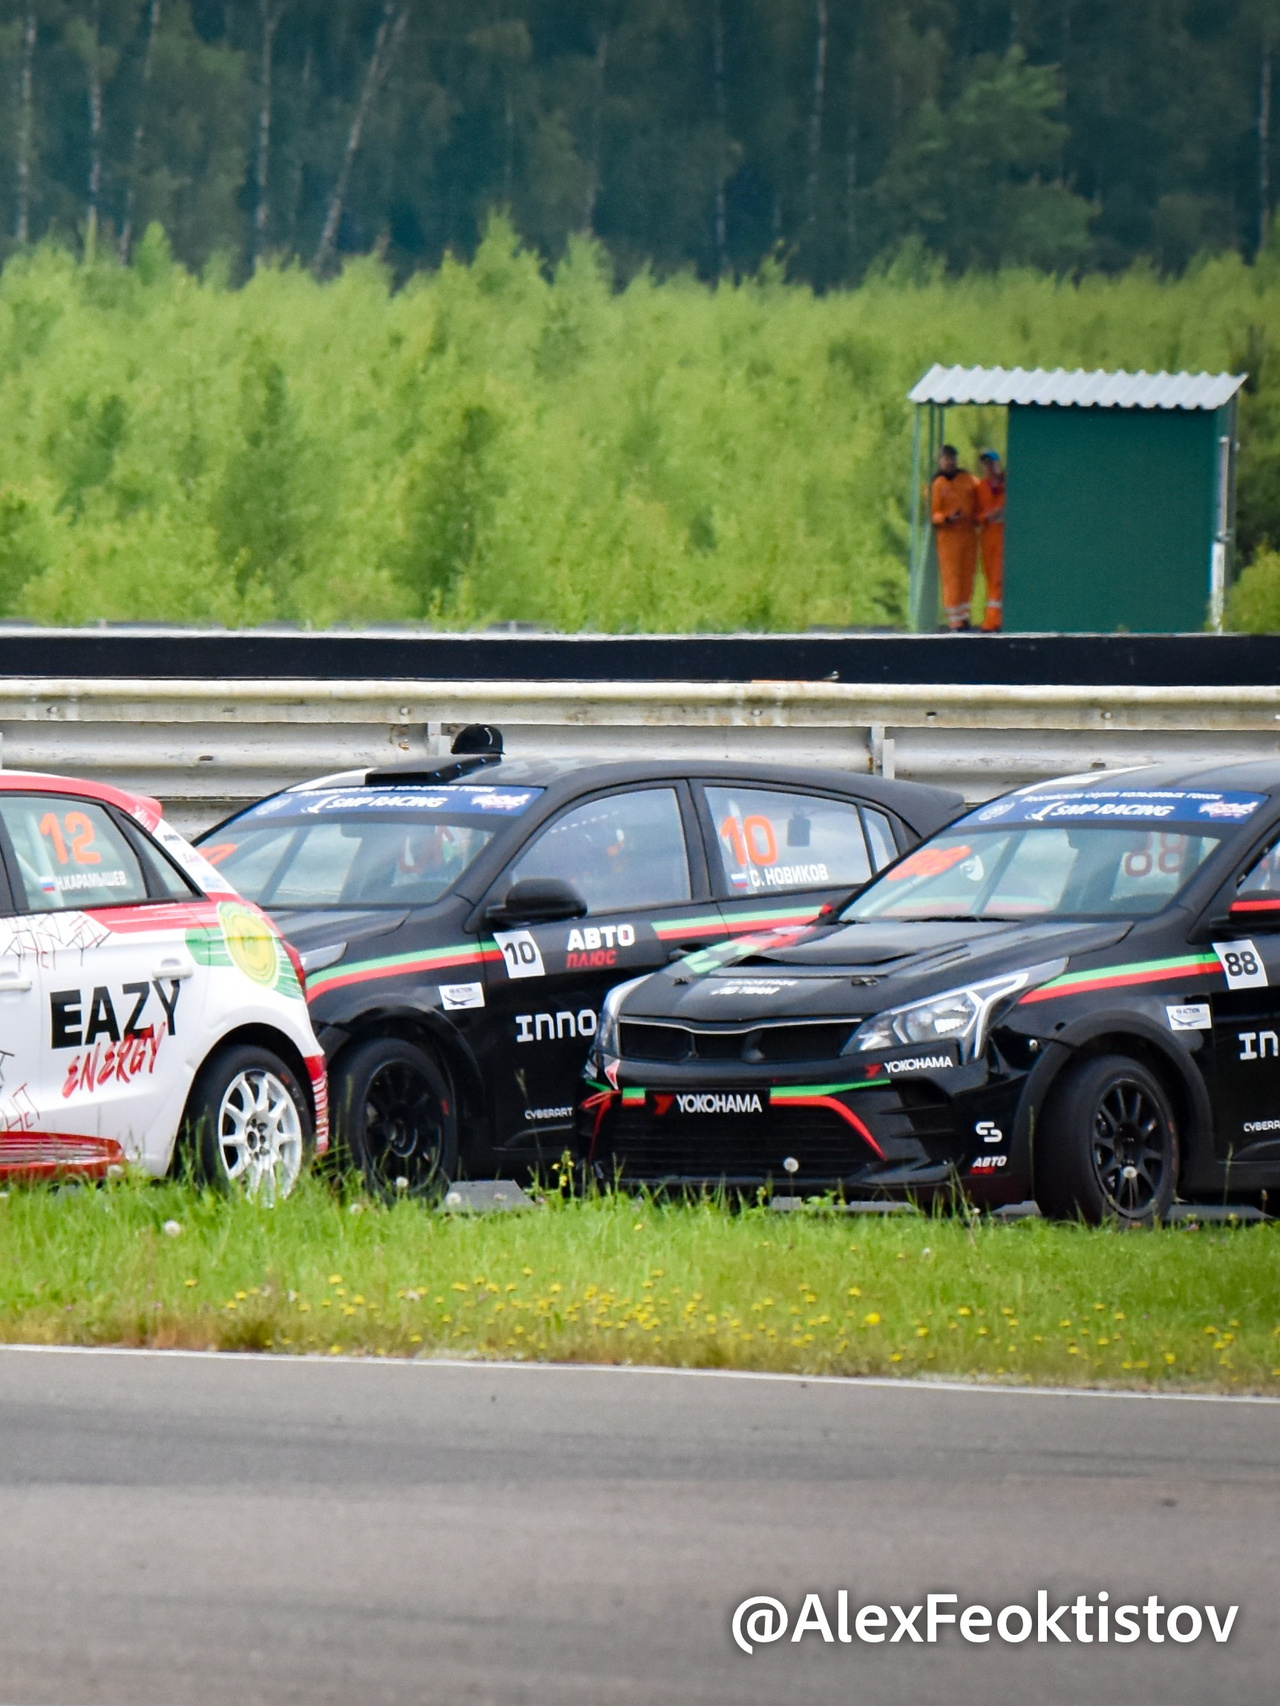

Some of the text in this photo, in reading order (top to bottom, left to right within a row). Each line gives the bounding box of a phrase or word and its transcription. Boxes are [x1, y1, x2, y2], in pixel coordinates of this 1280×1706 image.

[1095, 804, 1174, 817] RACING
[40, 811, 102, 865] 12
[721, 814, 779, 867] 10
[766, 863, 829, 886] НОВИКОВ
[567, 924, 635, 951] АВТО
[504, 941, 537, 966] 10
[566, 949, 618, 969] ПЛЮС
[1224, 951, 1259, 977] 88
[50, 978, 181, 1050] EAZY
[62, 1021, 167, 1099] ENERGY
[884, 1055, 954, 1074] YOKOHAMA
[524, 1106, 574, 1120] CYBERART
[675, 1093, 763, 1114] YOKOHAMA
[972, 1155, 1007, 1168] АВТО
